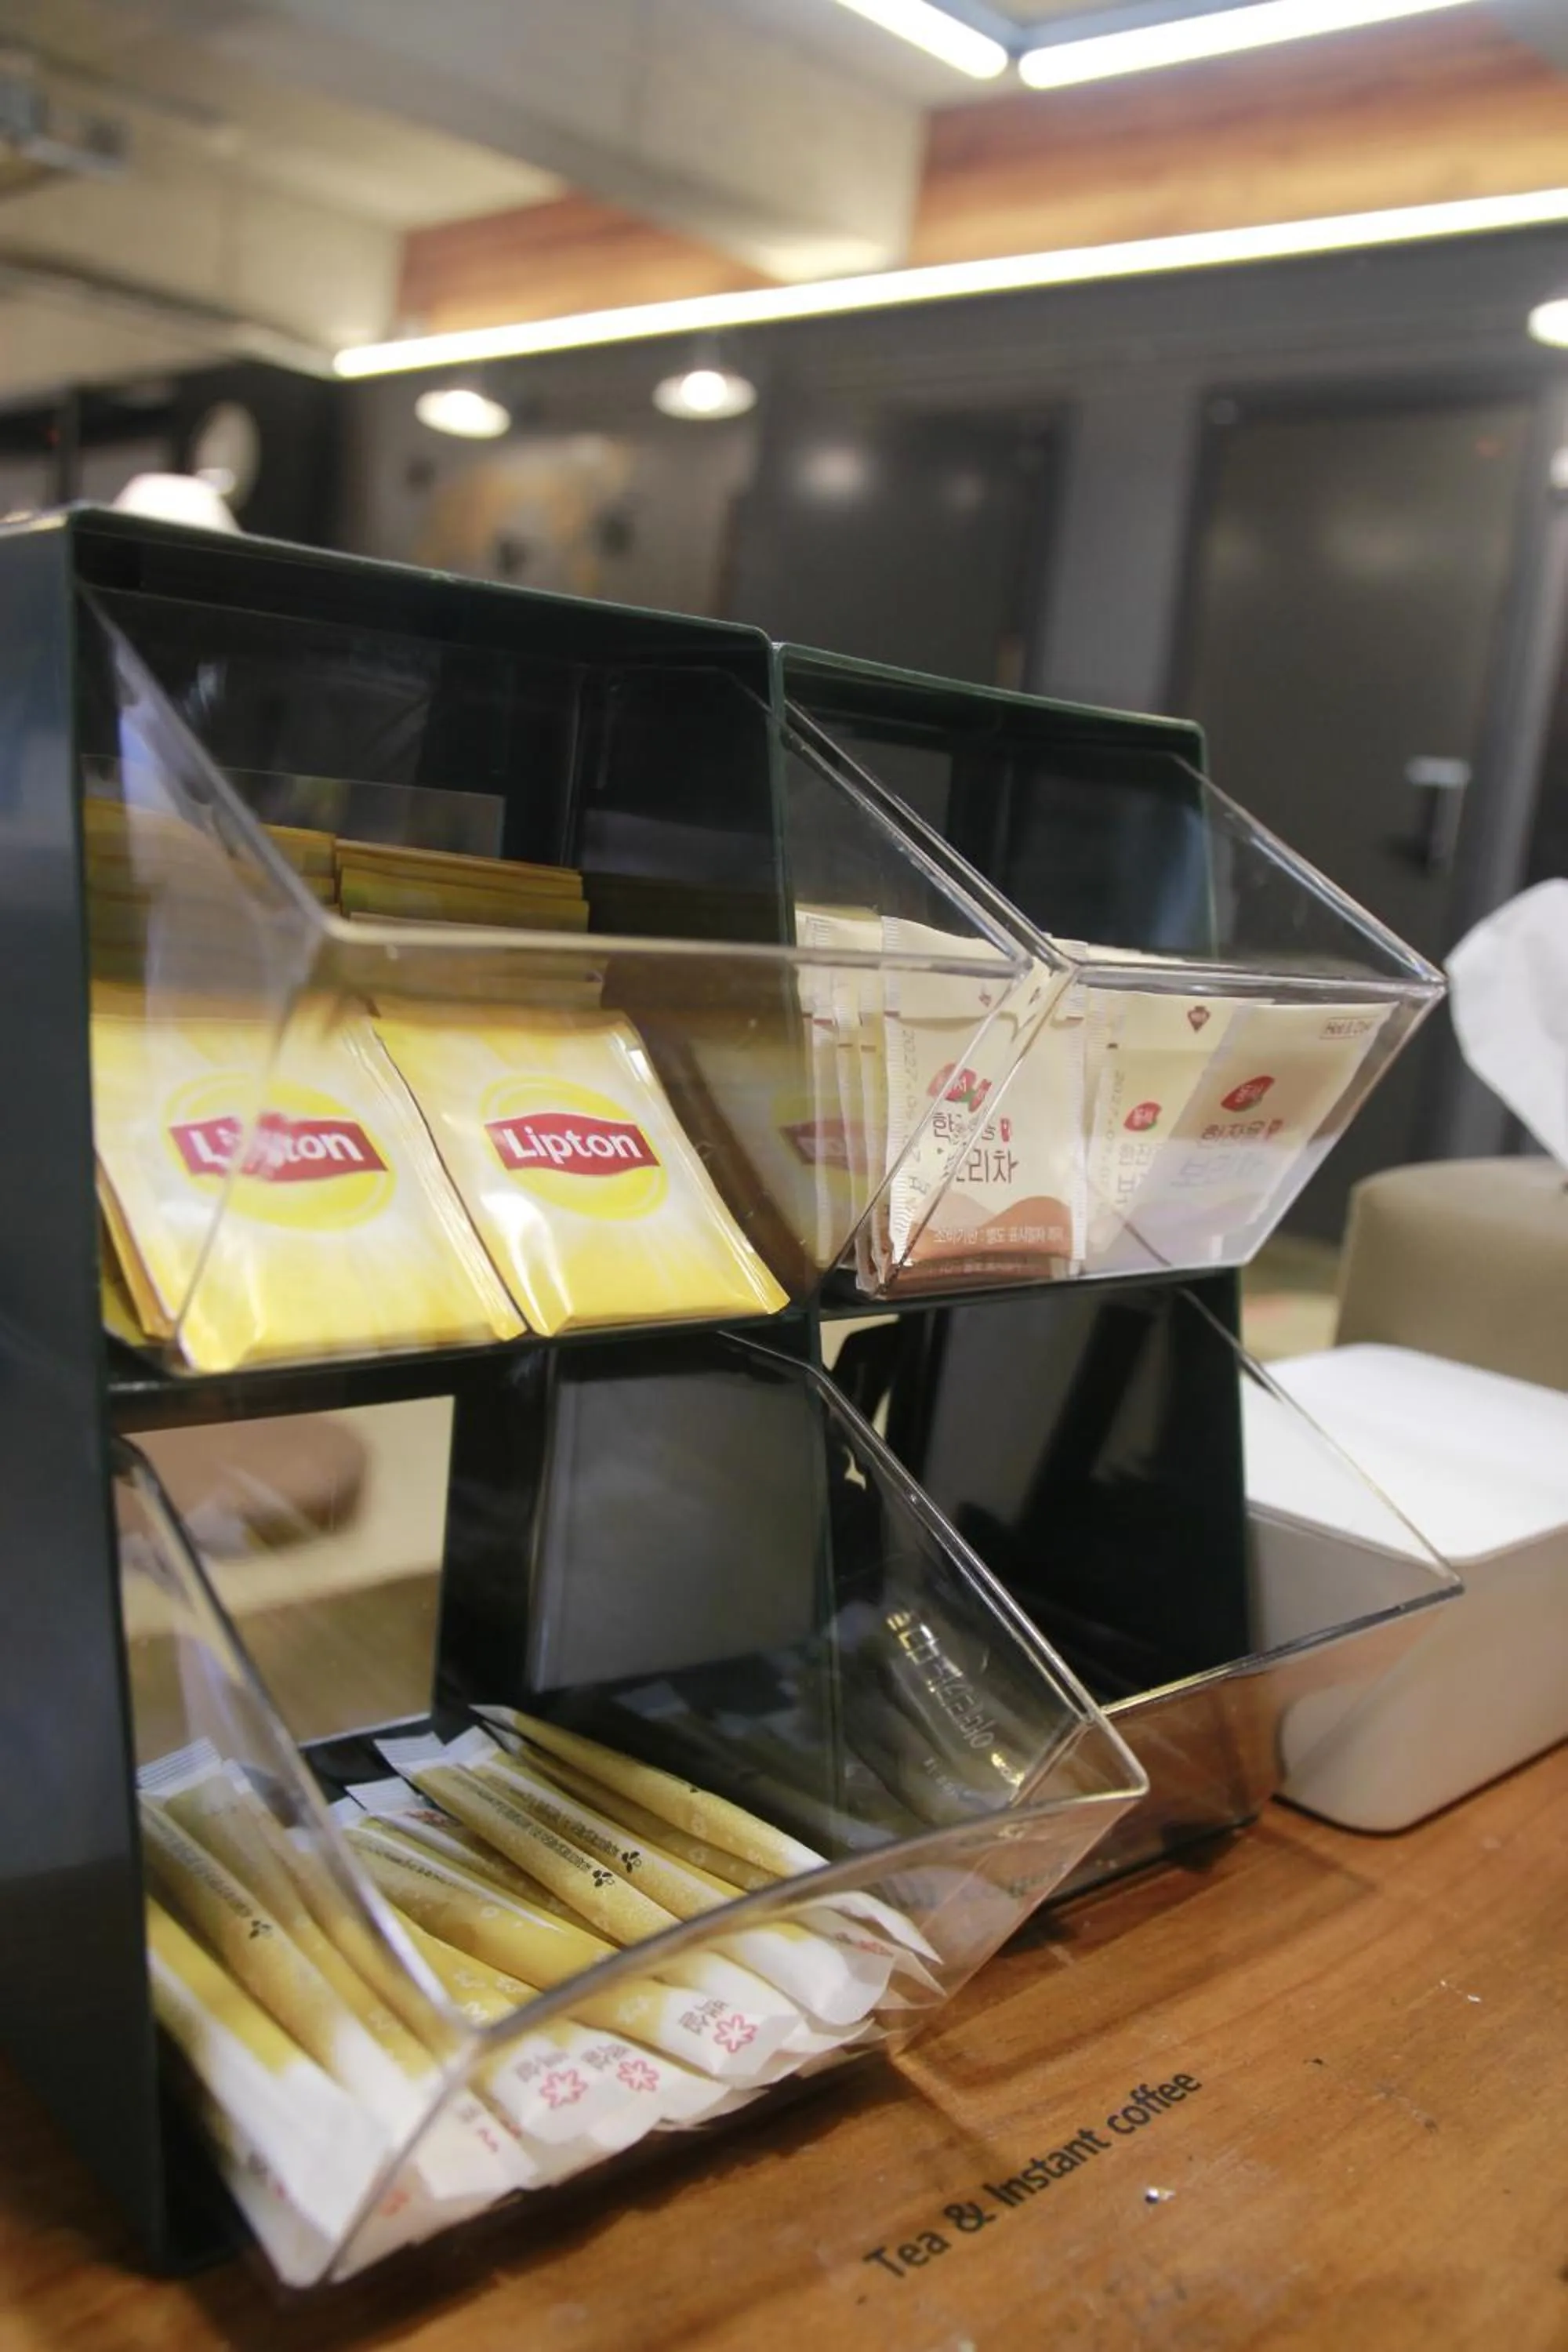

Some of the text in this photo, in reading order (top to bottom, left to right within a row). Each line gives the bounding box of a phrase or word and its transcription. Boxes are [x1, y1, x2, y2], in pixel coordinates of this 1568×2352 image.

[188, 1127, 365, 1169] Lton
[503, 1125, 644, 1165] Lipton
[955, 1148, 1020, 1184] 리차
[864, 2071, 1203, 2279] Tea & Instant coffee
